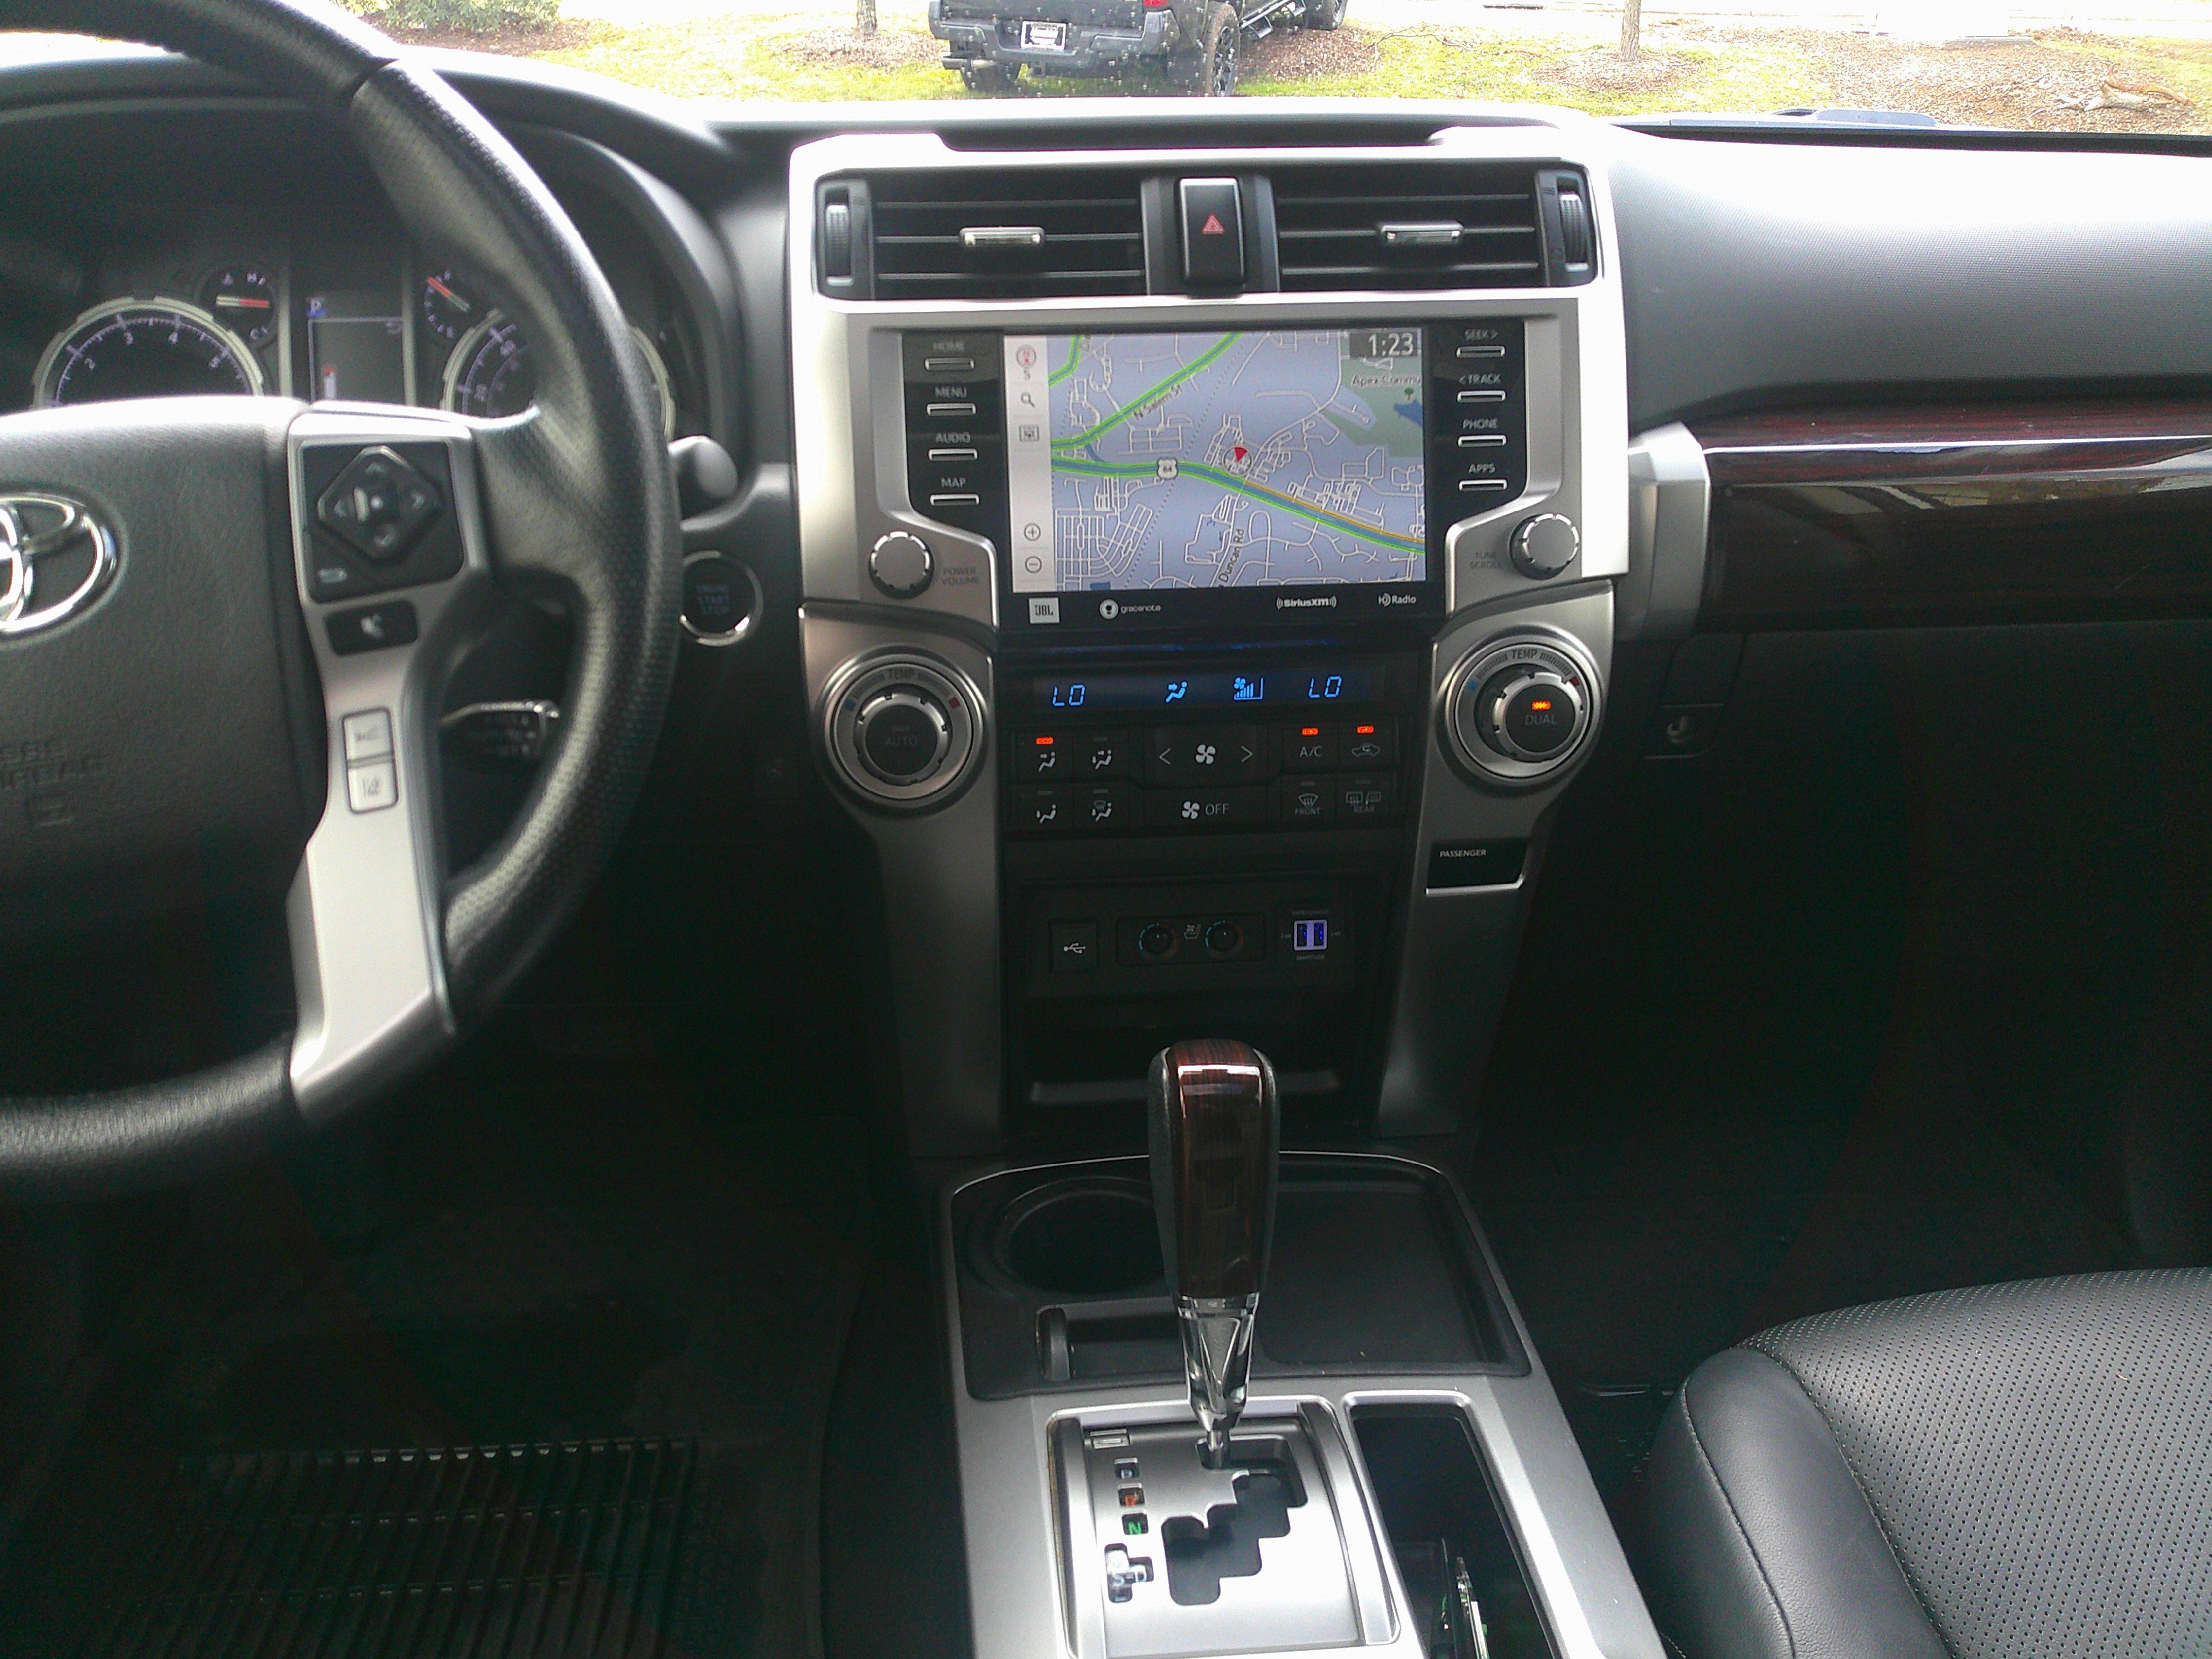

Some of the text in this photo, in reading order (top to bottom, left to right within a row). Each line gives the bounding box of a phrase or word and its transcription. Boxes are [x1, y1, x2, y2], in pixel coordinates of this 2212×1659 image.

[933, 341, 965, 352] HOME
[1368, 332, 1414, 356] 1:23
[1469, 374, 1501, 384] TRACK
[935, 387, 967, 398] MENU
[1463, 419, 1498, 429] PHONE
[936, 431, 971, 442] AUDIO
[1469, 463, 1495, 473] APPS
[941, 478, 966, 488] MAP
[1218, 529, 1244, 583] Duncan Rd
[1392, 595, 1417, 604] Radio
[1035, 604, 1053, 615] JBL
[1121, 605, 1161, 614] gracenote
[1511, 649, 1537, 660] TEMP
[1525, 714, 1557, 725] DUAL
[1300, 745, 1322, 758] A/C
[1206, 804, 1229, 815] OFF
[1295, 807, 1320, 816] FRONT
[1439, 849, 1487, 858] PASSENGER
